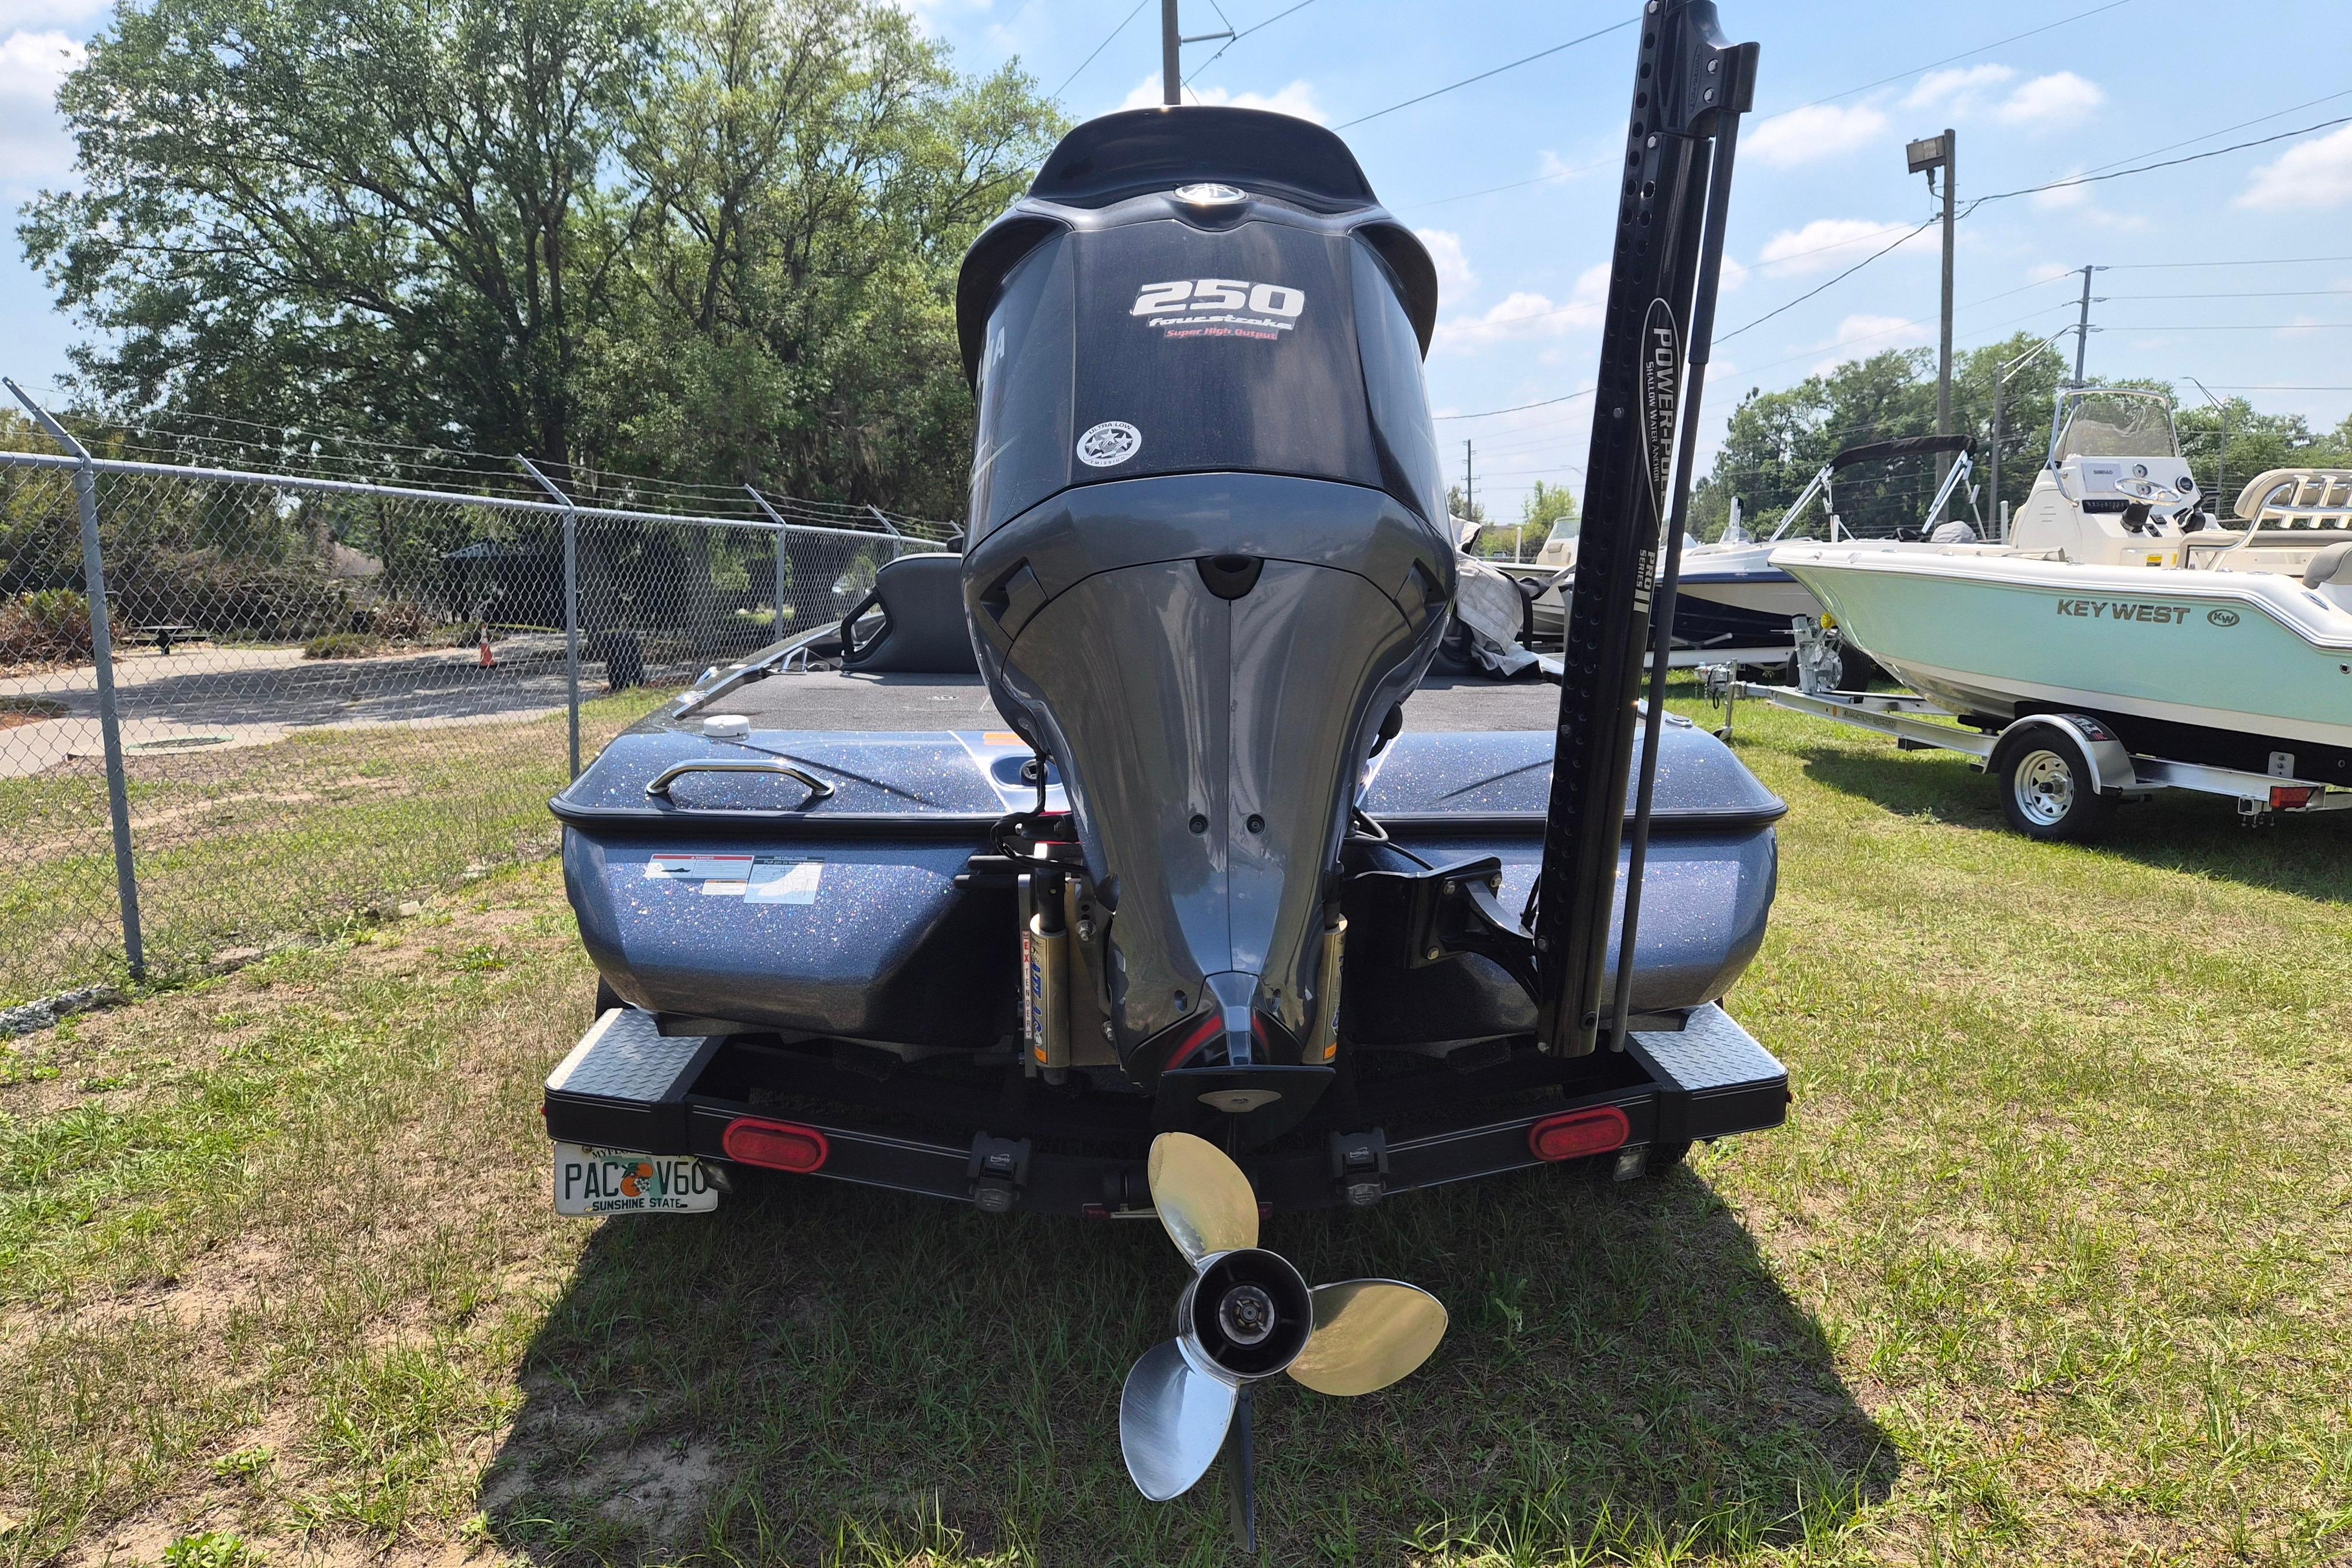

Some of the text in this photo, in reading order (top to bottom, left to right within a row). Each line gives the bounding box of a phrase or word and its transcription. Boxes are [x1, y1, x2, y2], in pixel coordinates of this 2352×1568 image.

[1132, 279, 1305, 316] 250
[1166, 327, 1277, 340] Super High Output
[1088, 422, 1132, 434] ULTRA LOW
[1646, 361, 1659, 483] SHALLOW WATER ANCHOR
[1653, 327, 1673, 505] POWER-POLE
[1636, 549, 1647, 588] SERIES
[1643, 550, 1656, 591] PRO
[2057, 599, 2109, 618] KEY
[2112, 603, 2191, 624] WEST
[565, 1161, 619, 1200] PAC
[592, 1197, 681, 1212] SUNSHINE STATE
